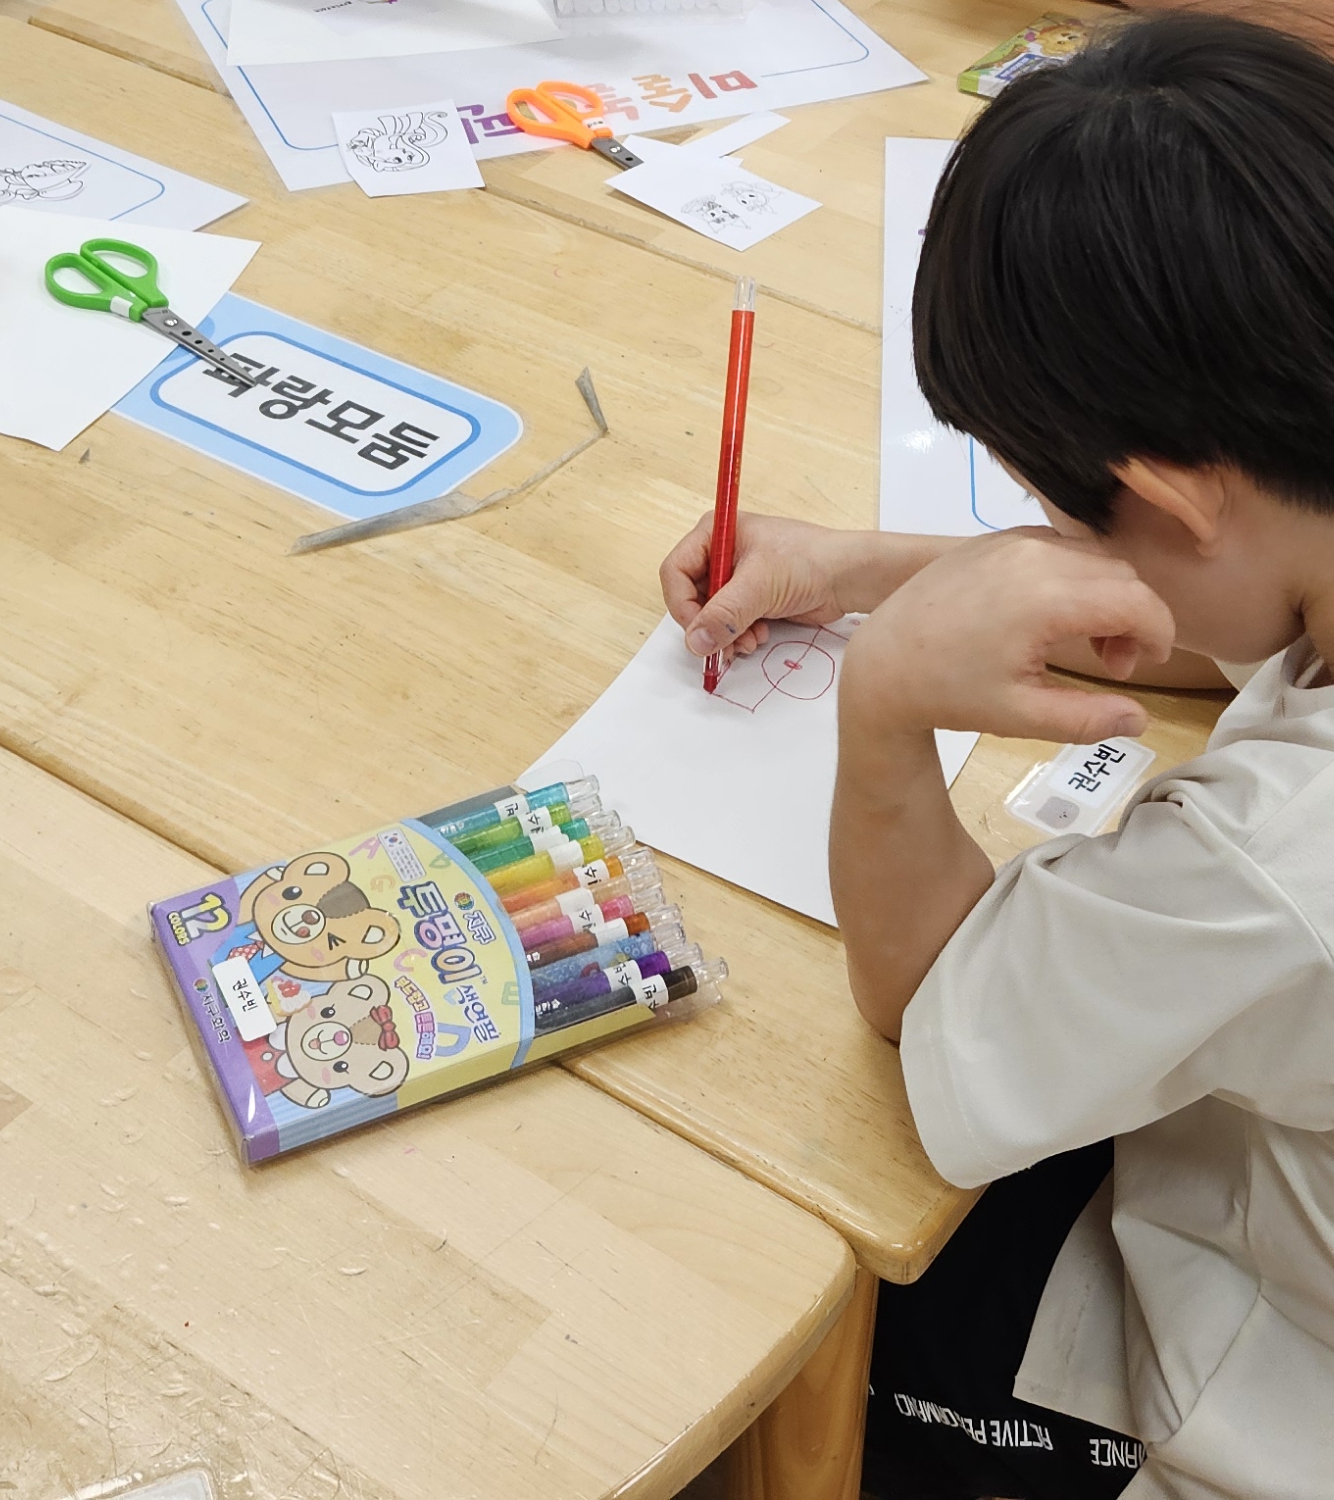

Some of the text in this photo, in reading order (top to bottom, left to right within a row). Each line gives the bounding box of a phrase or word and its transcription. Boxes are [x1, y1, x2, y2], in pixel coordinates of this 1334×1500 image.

[202, 352, 441, 471] 파랑모둠
[1067, 743, 1127, 793] 권수빈
[168, 910, 192, 947] COLORS
[181, 891, 233, 941] 12
[463, 910, 497, 946] 지구
[397, 880, 483, 985] 투명이
[456, 984, 502, 1044] 색연필
[232, 977, 259, 1013] 권수빈
[393, 975, 431, 1013] 부드럽고
[201, 993, 233, 1043] 지구화학
[990, 1418, 1055, 1451] ACTIVE
